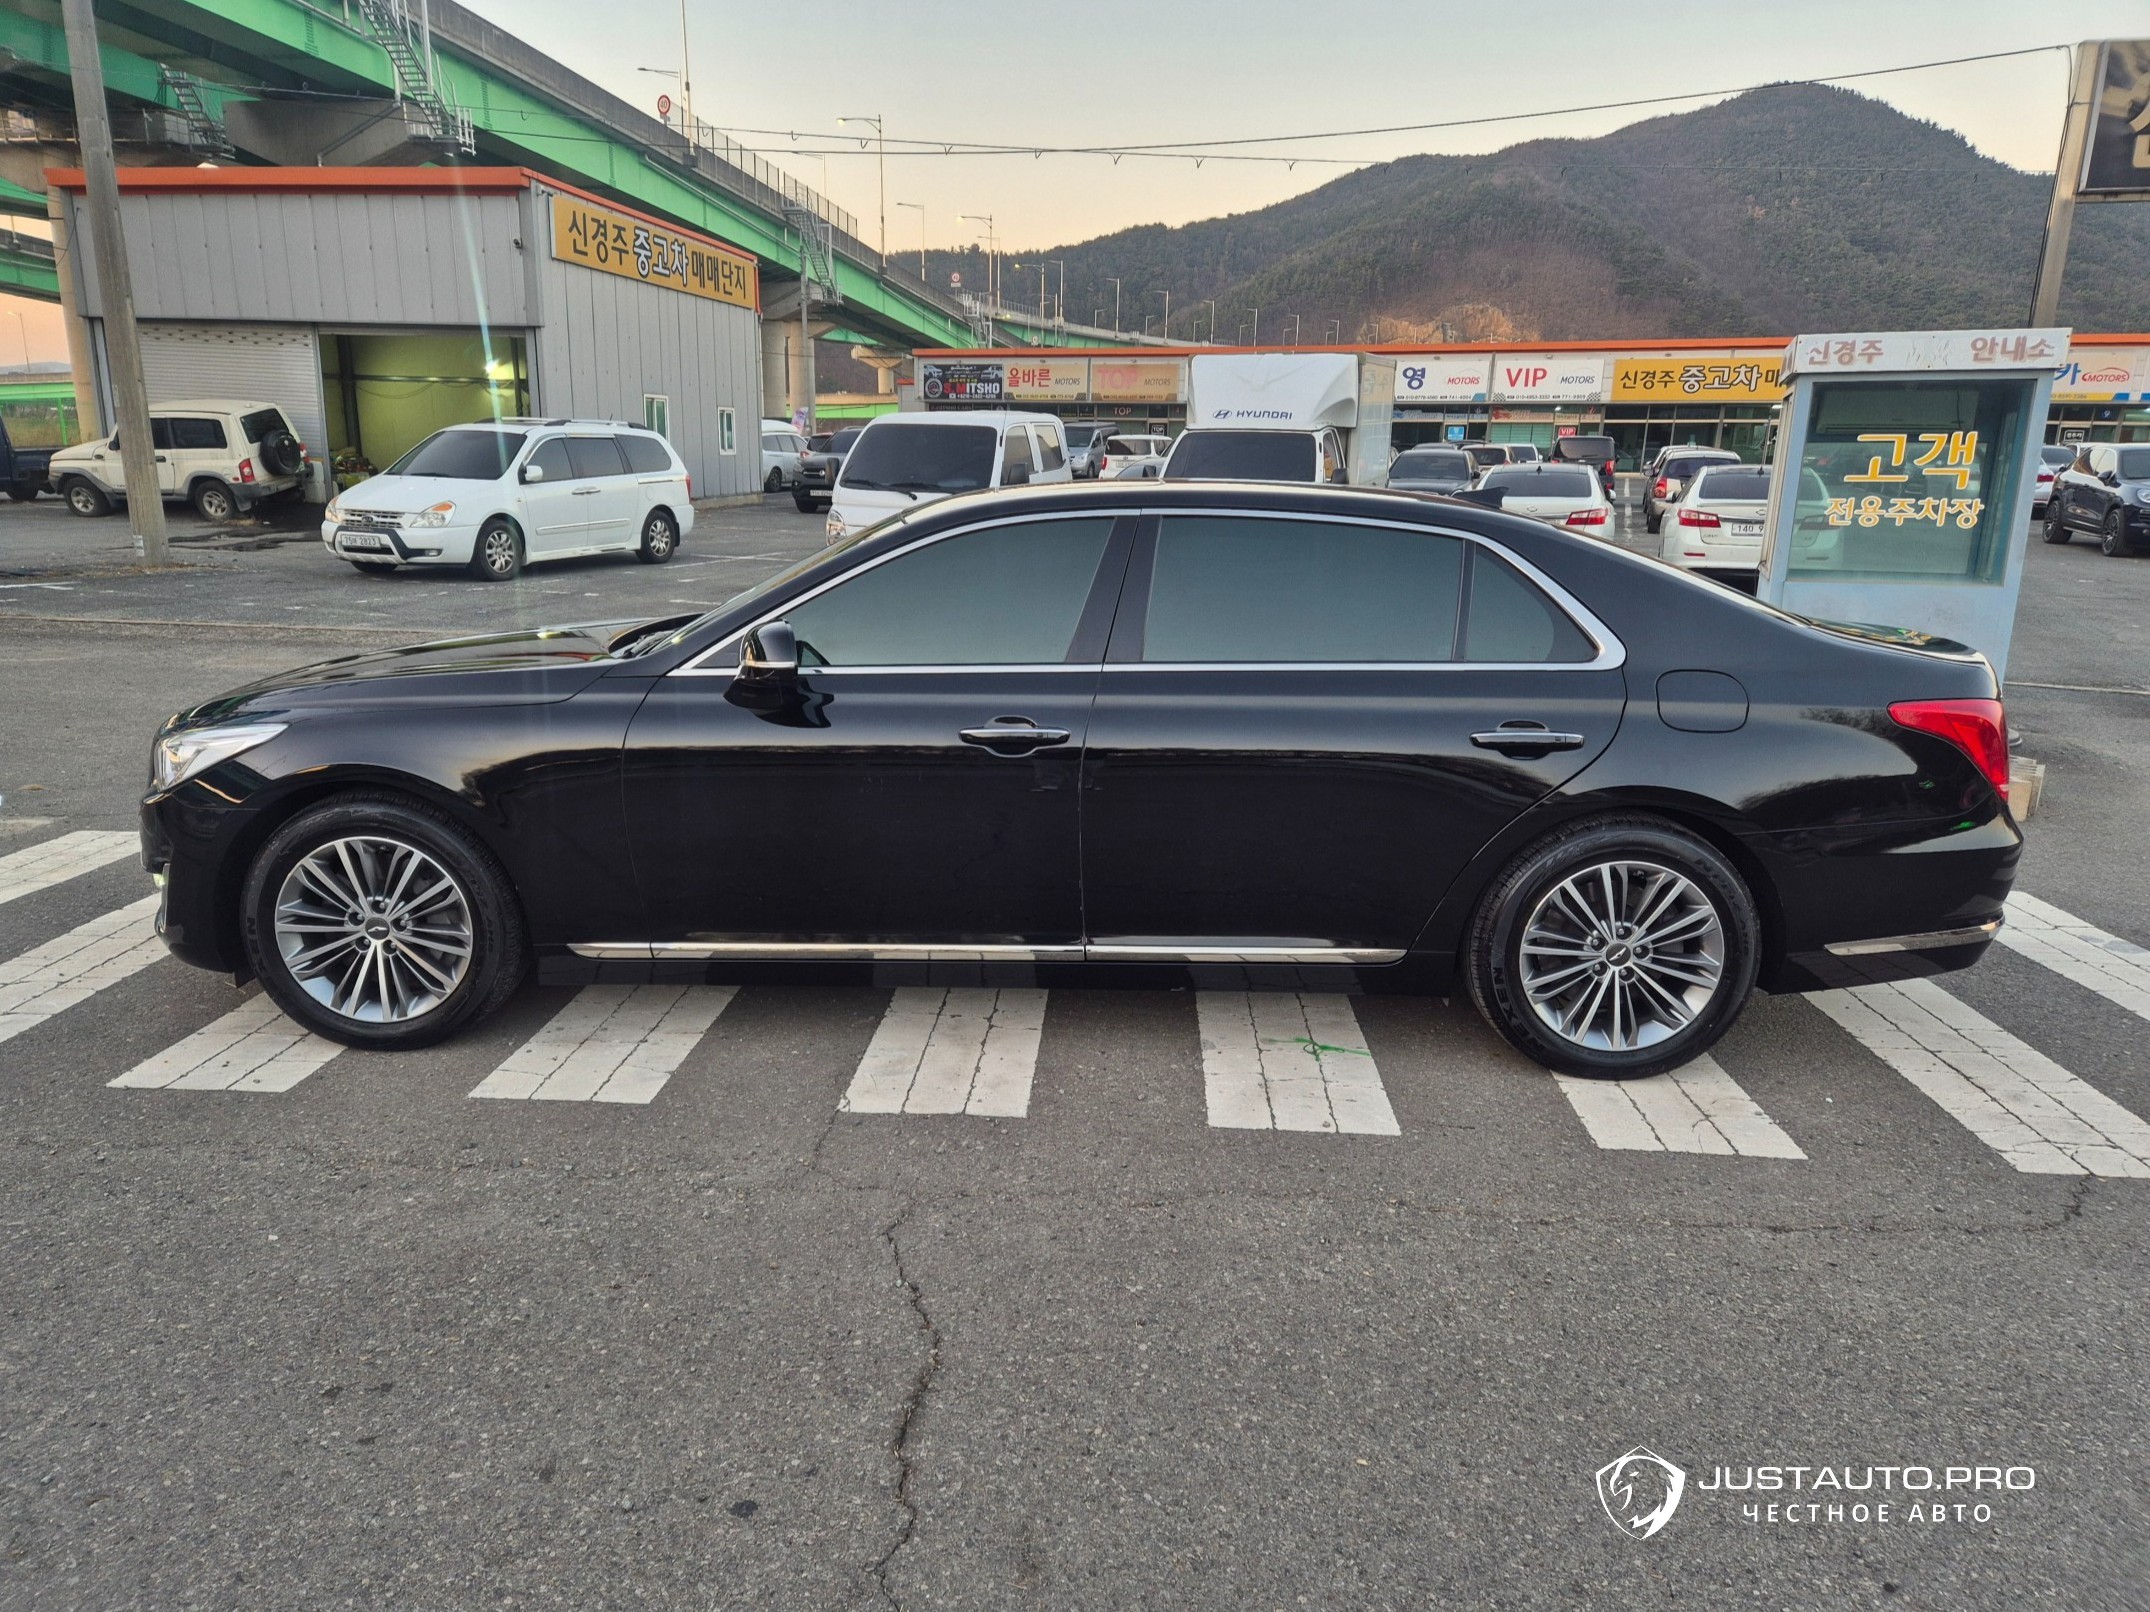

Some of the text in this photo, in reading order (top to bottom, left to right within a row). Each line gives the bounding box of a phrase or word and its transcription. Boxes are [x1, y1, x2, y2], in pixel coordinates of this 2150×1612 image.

[568, 209, 747, 300] 신경주 중고차 매매단지
[1808, 339, 1884, 366] 신경주
[1970, 335, 2055, 362] 안내소
[1007, 367, 1052, 388] 올바른
[1054, 377, 1081, 386] MOTORS
[1097, 367, 1171, 390] TOP MOTORS
[1402, 366, 1426, 391] 영
[1446, 376, 1481, 385] MOTORS
[1505, 367, 1596, 388] VIP MOTORS
[1619, 369, 1676, 390] 신경주
[1679, 364, 1762, 393] 중고차
[2087, 374, 2127, 383] MOTORS
[1114, 406, 1132, 416] TOP
[1236, 410, 1293, 421] HYUNDAI
[1843, 430, 1979, 491] 고객
[1823, 496, 1985, 529] 전용주차장
